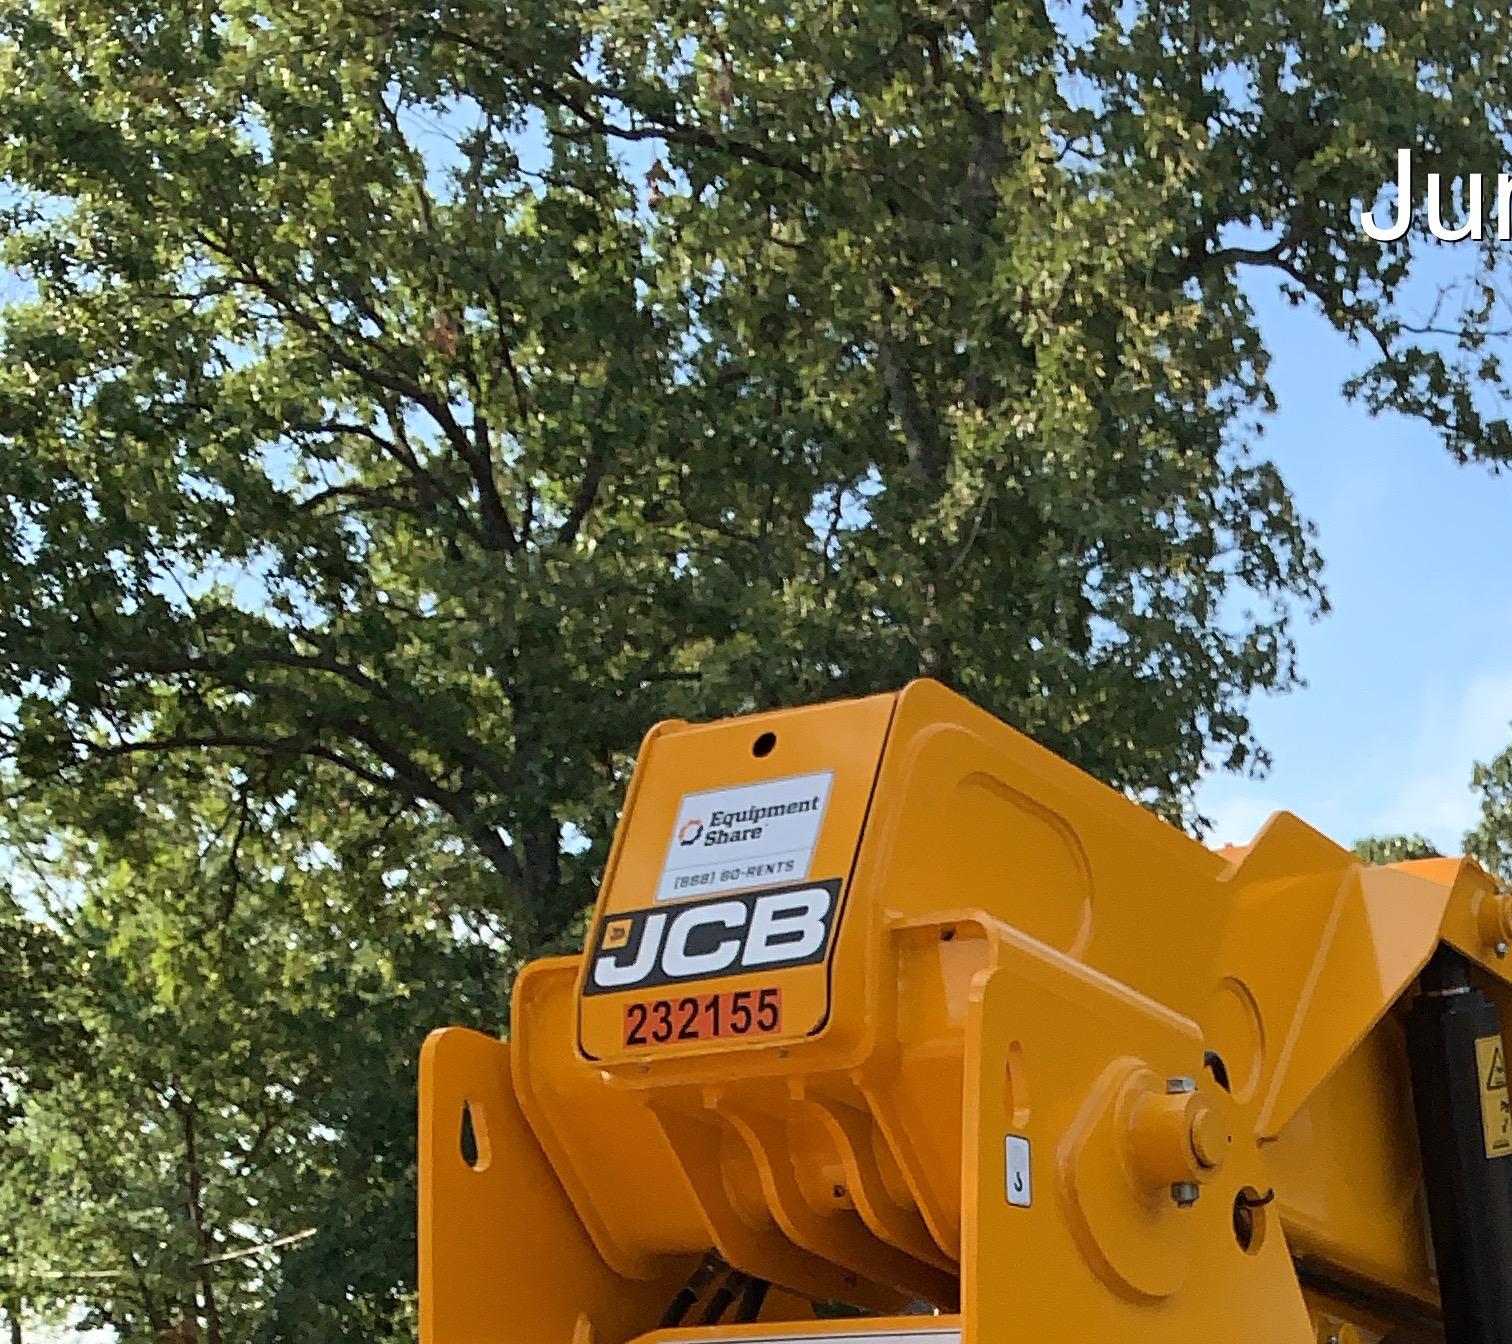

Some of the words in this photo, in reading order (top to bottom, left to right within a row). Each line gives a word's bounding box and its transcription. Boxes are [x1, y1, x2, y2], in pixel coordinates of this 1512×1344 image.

[709, 796, 821, 828] Equipment
[704, 826, 763, 846] Share
[594, 888, 832, 987] JCB
[626, 989, 780, 1046] 232155
